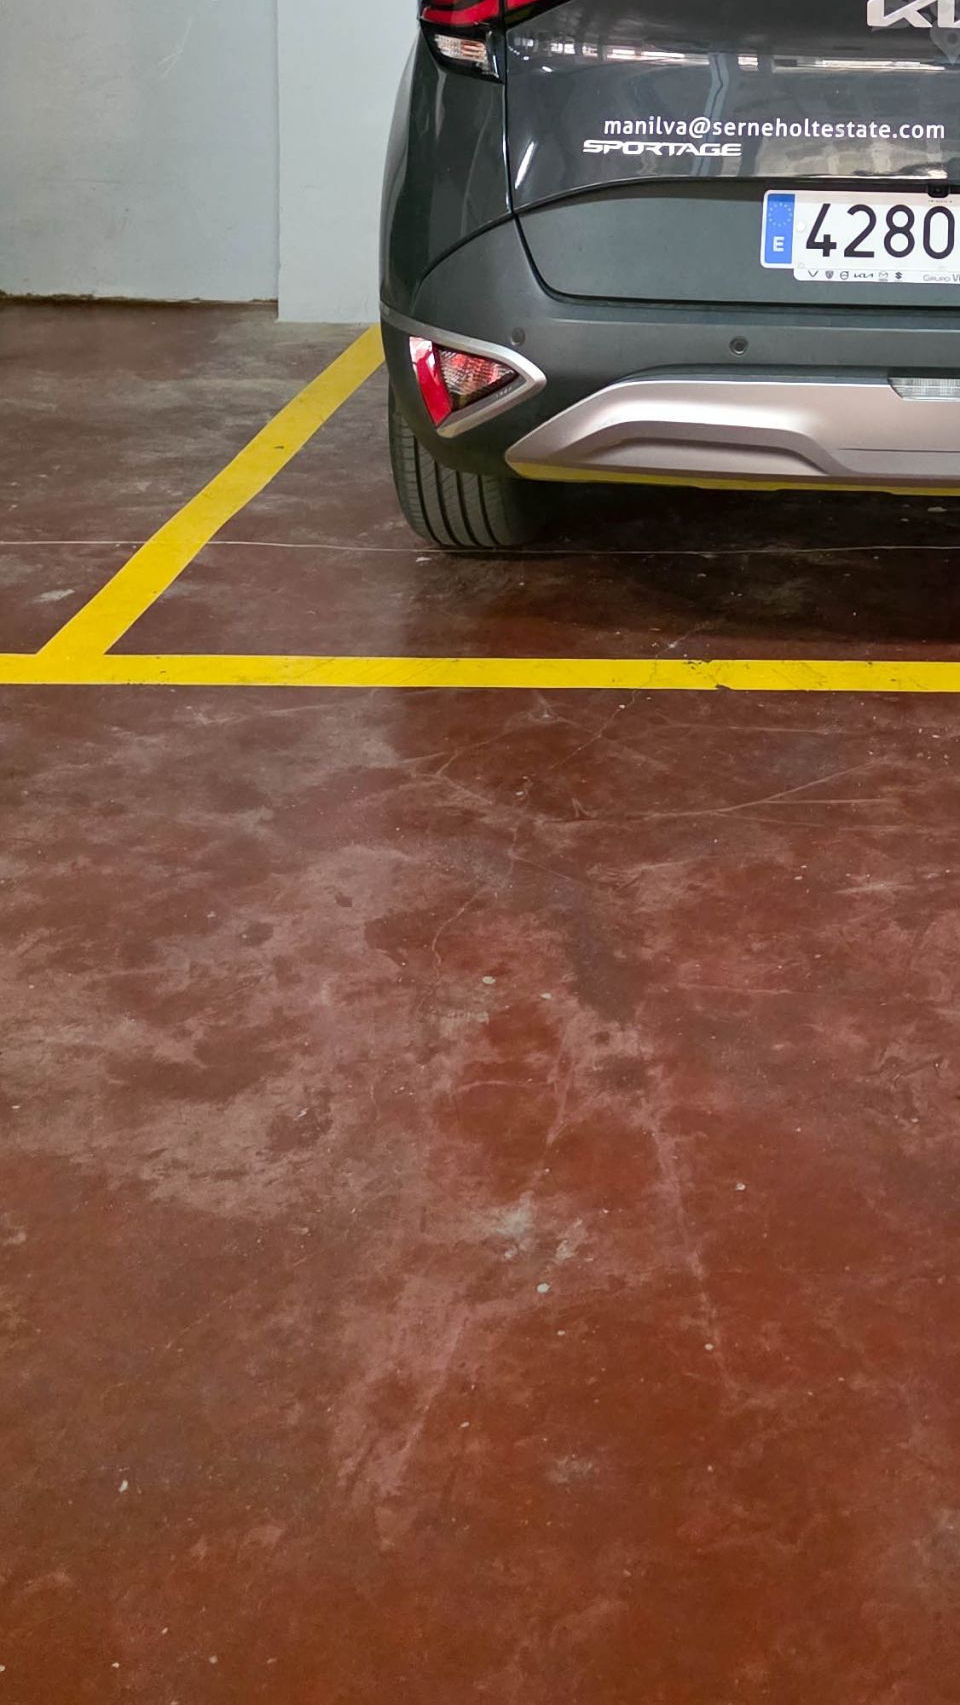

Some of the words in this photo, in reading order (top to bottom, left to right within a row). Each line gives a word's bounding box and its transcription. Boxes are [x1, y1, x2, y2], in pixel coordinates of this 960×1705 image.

[603, 116, 946, 139] manilva@serneholtestate.com
[582, 139, 742, 157] SPORTAGE
[805, 203, 955, 260] 4280
[773, 237, 784, 252] E
